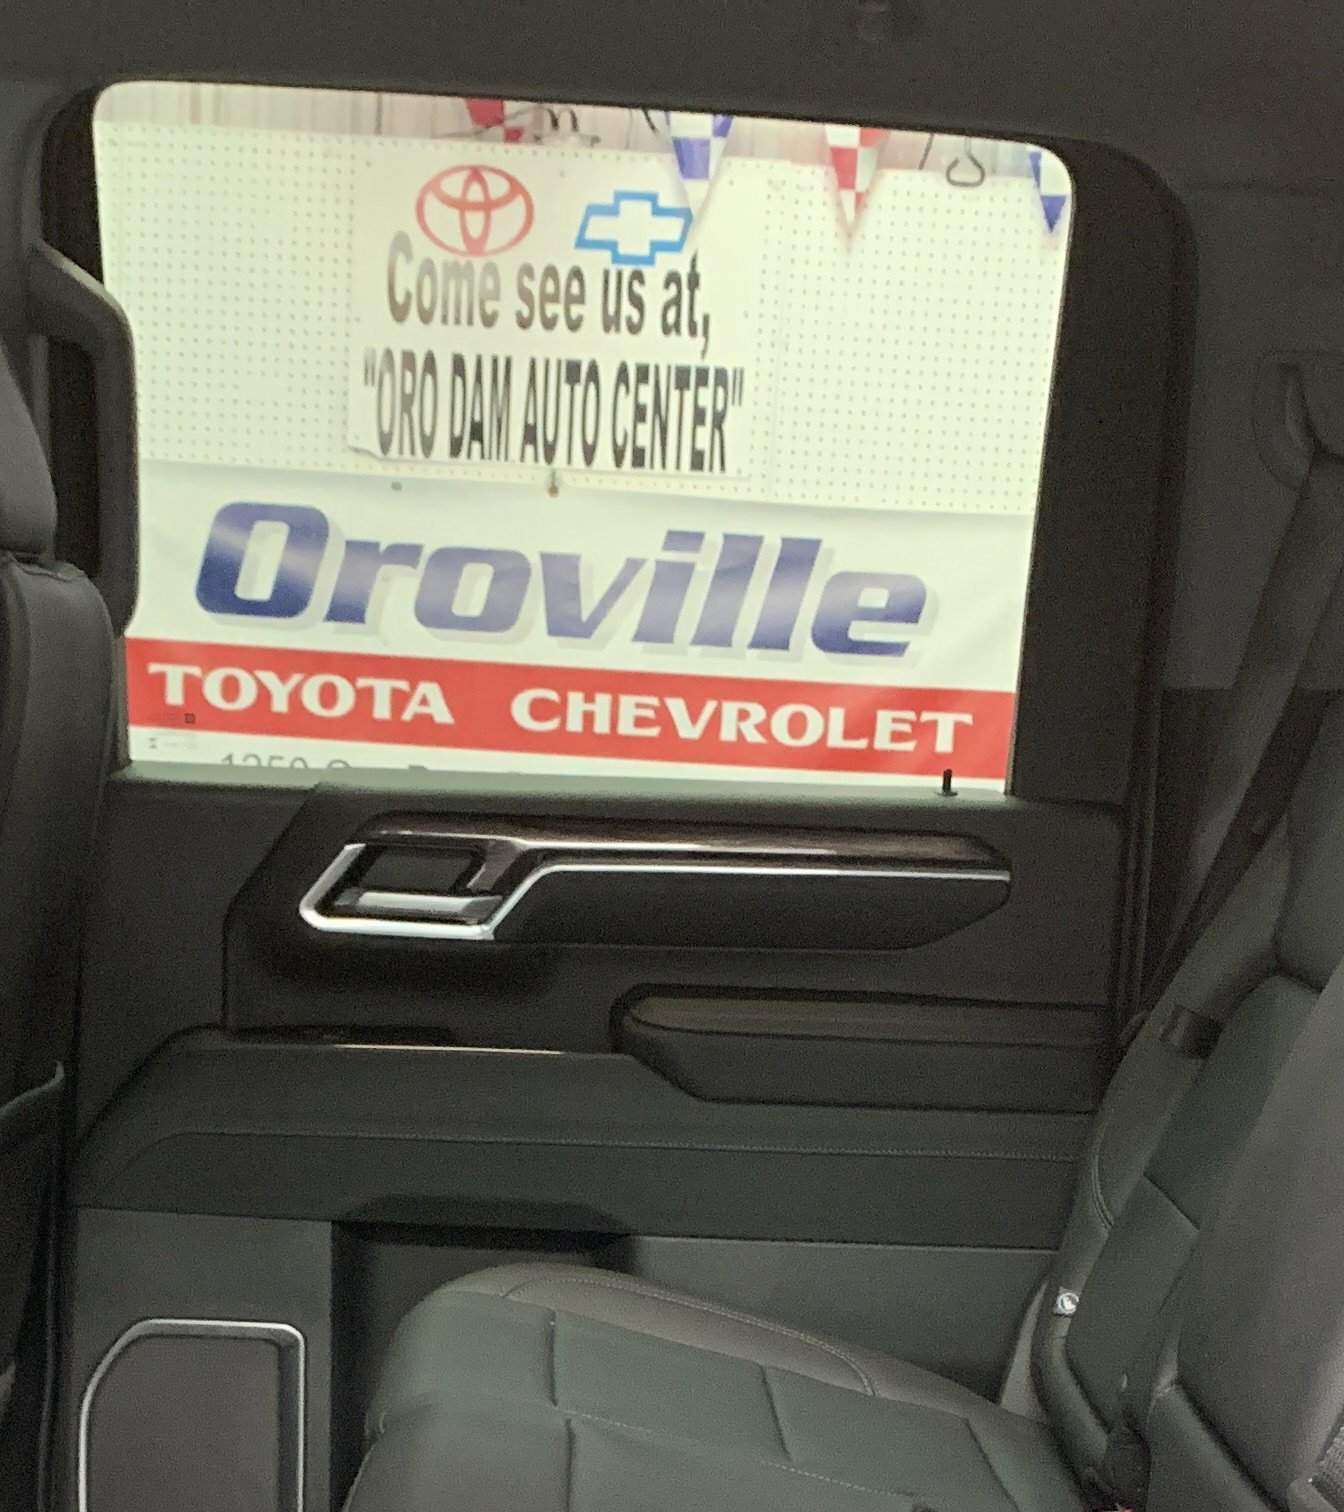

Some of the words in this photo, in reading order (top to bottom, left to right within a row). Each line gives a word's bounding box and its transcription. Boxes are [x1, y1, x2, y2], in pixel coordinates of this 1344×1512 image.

[387, 230, 501, 329] Come
[515, 262, 587, 332] see
[602, 267, 647, 336] us
[660, 250, 711, 359] at,
[363, 345, 439, 459] "ORO
[450, 351, 513, 463] DAM
[520, 356, 602, 468] AUTO
[611, 359, 745, 474] CENTER"
[194, 500, 928, 659] Oroville
[147, 662, 455, 725] TOYOTA
[510, 687, 973, 754] CHEVROLET
